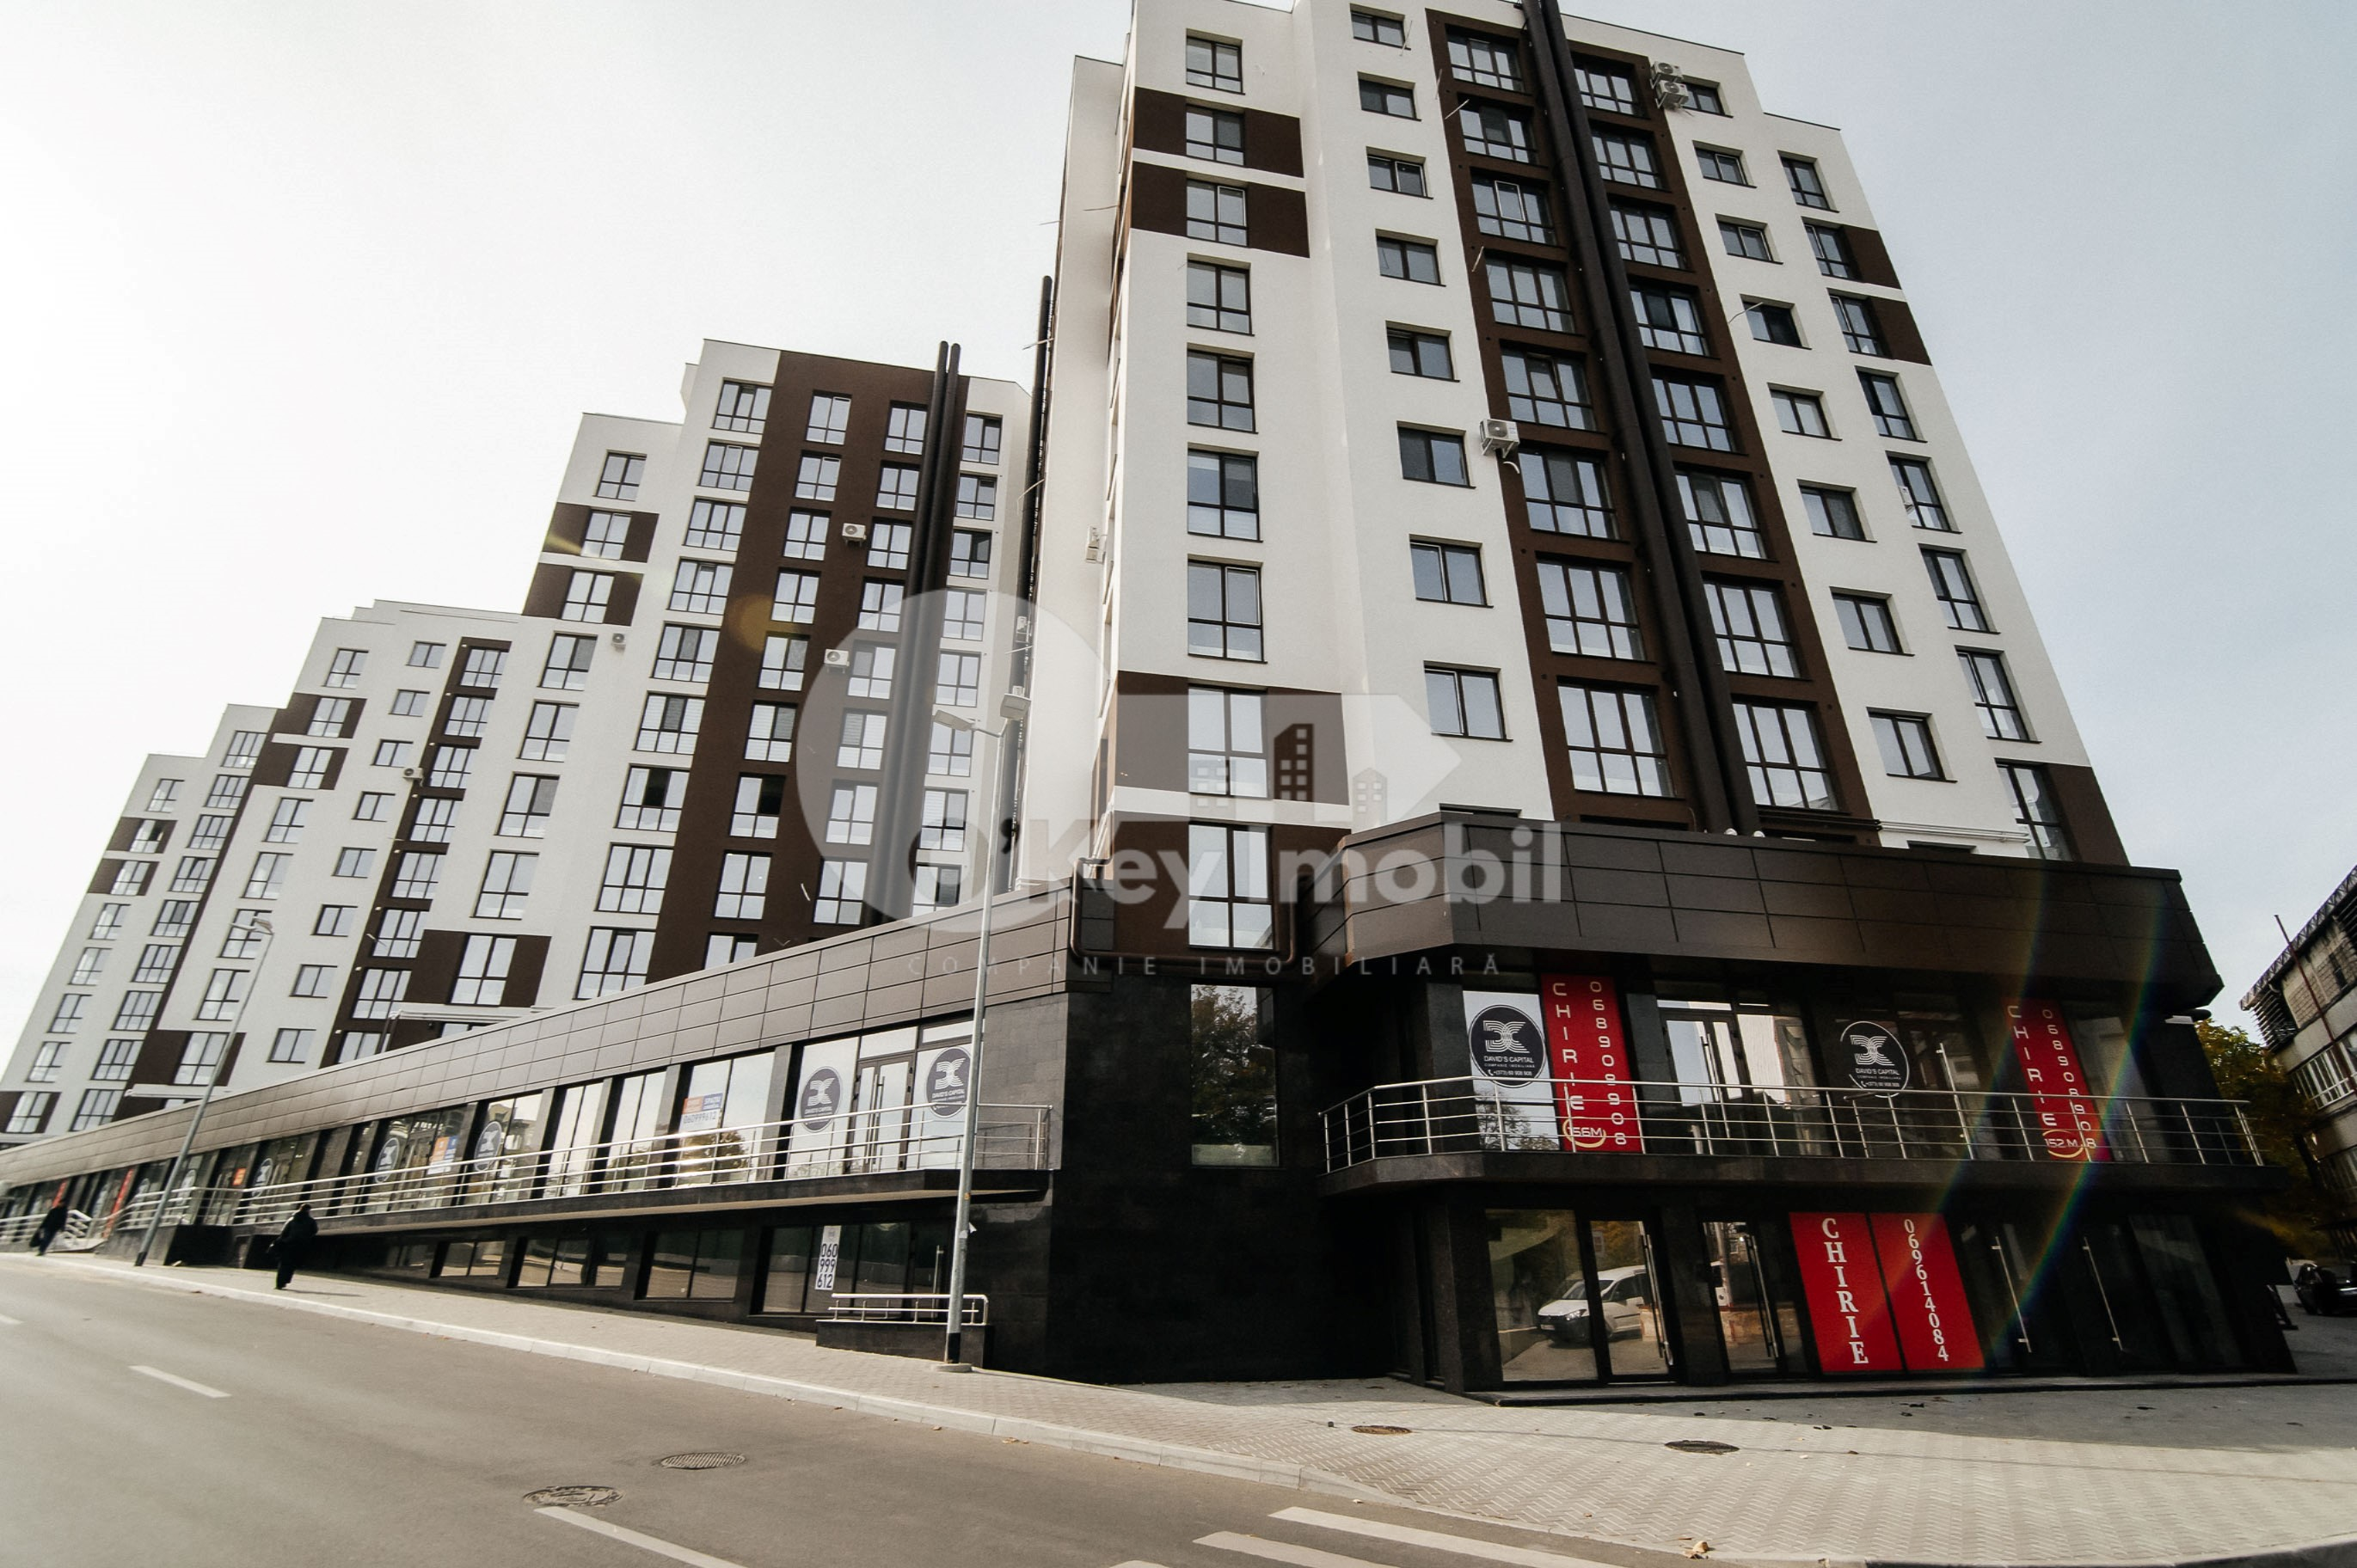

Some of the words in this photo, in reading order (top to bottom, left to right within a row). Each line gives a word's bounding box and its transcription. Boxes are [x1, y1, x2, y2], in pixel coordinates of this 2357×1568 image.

[1552, 983, 1585, 1111] CHIRIE
[2006, 1005, 2059, 1127] CHIRIE
[817, 1273, 833, 1289] 612
[819, 1258, 837, 1273] 999
[821, 1243, 838, 1258] 060
[1821, 1217, 1869, 1365] CHIRIE
[1903, 1218, 1949, 1362] 069614084
